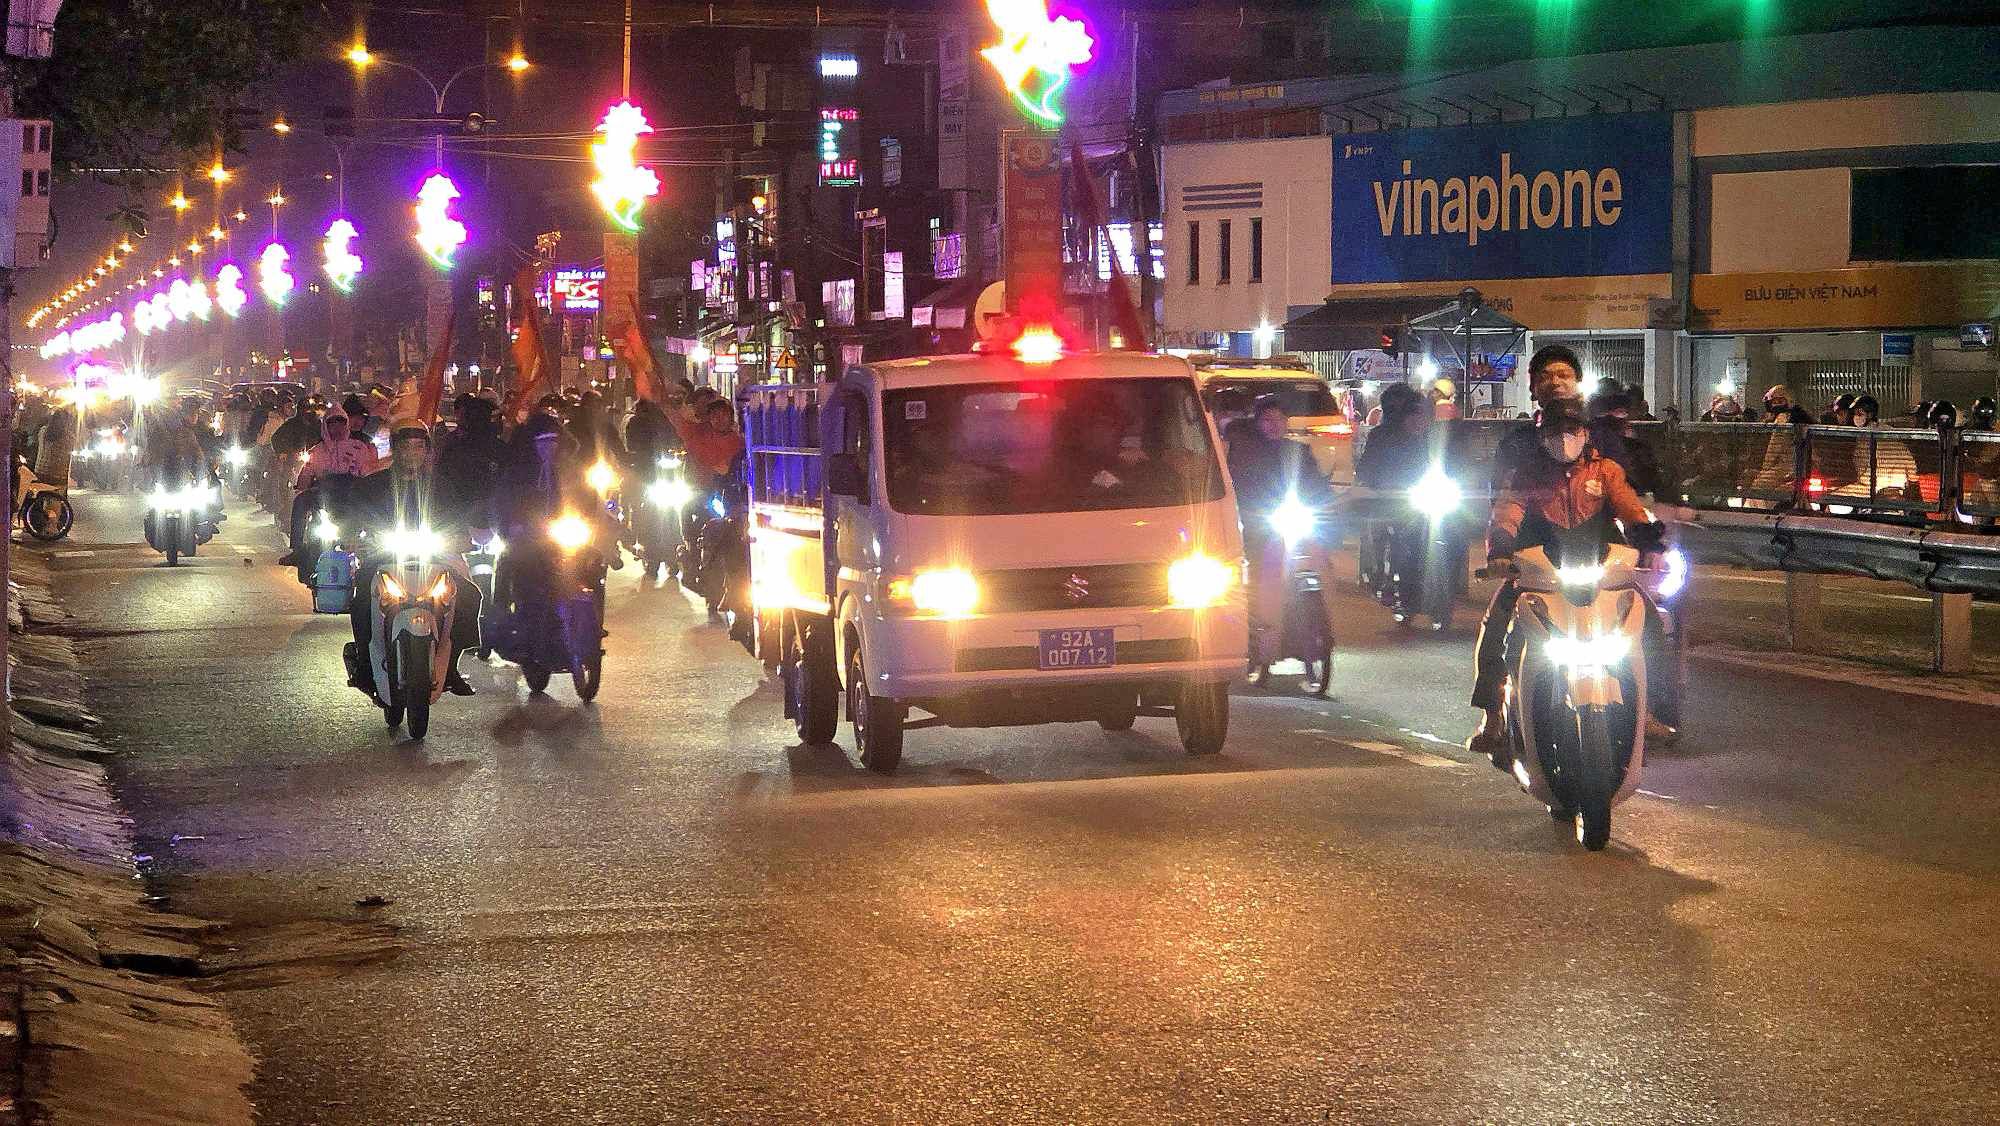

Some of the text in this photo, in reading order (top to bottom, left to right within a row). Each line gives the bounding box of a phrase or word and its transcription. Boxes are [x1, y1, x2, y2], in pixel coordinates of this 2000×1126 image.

[1353, 146, 1375, 156] VNPT
[1373, 152, 1623, 246] vinaphone
[1744, 283, 1879, 304] BƯU ĐIỆN VIỆT NAM
[1061, 630, 1094, 647] 92A
